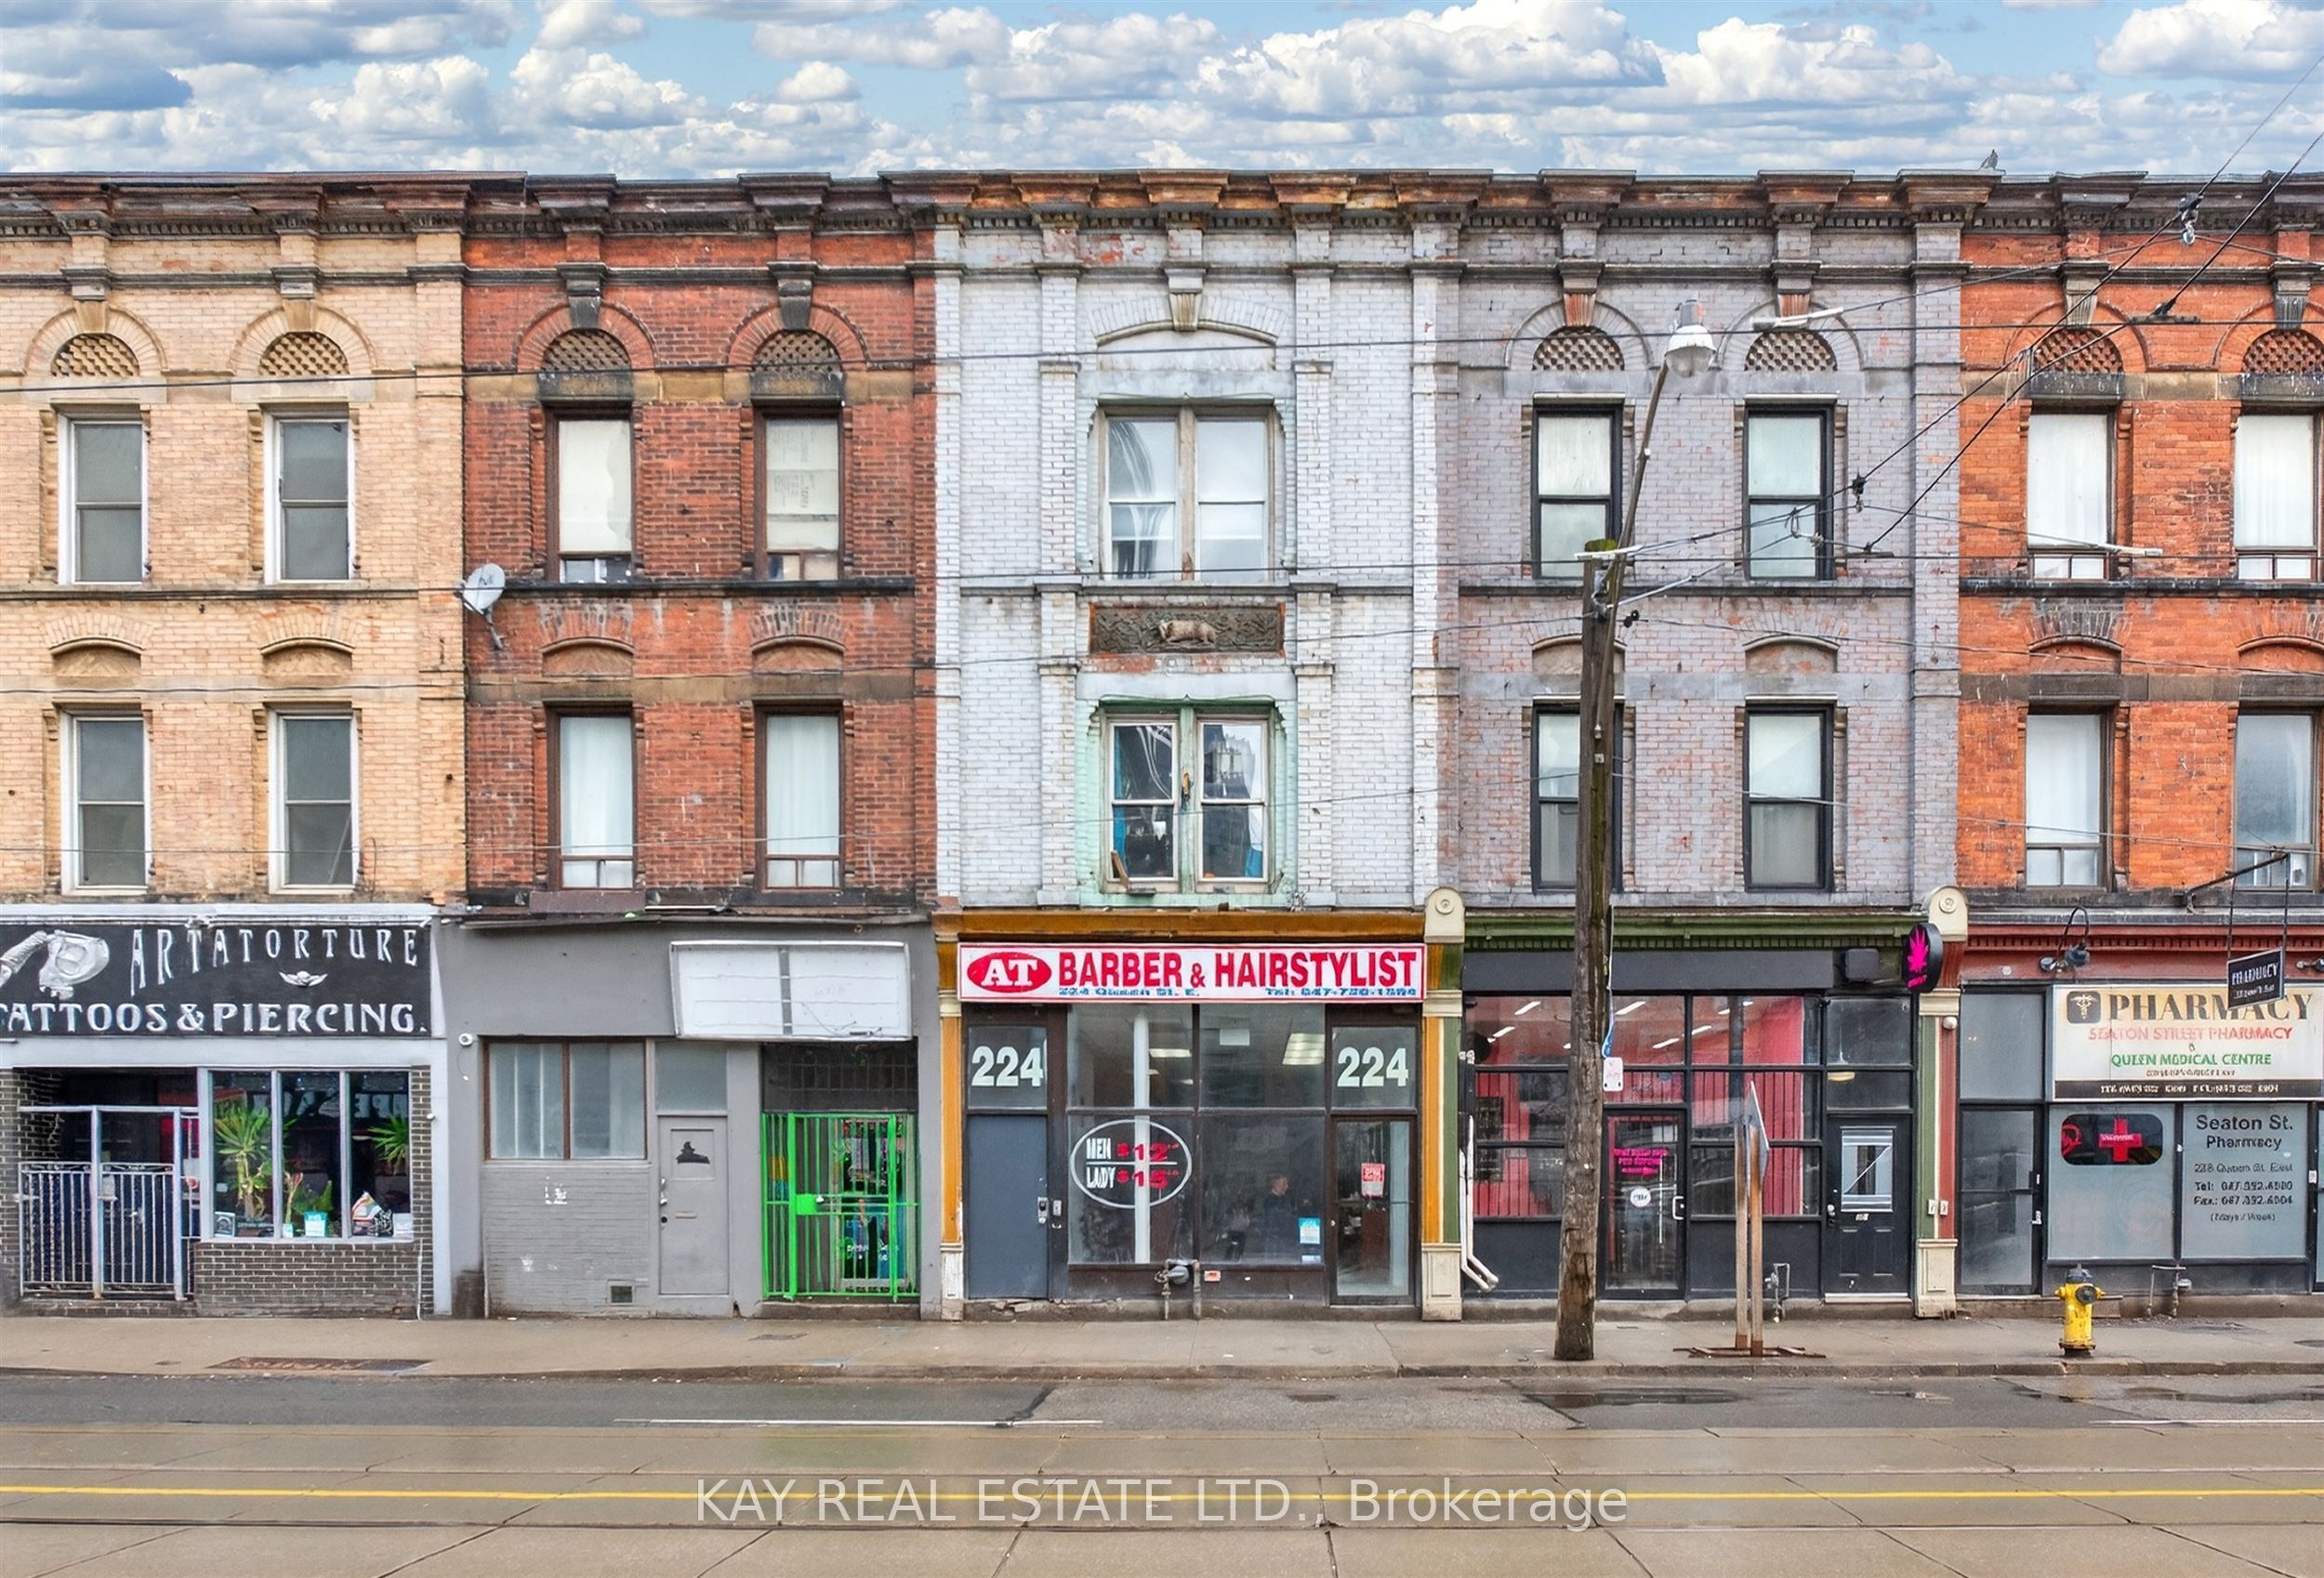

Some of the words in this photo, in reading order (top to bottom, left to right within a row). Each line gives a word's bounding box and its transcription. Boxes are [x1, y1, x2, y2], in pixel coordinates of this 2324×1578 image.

[981, 959, 1037, 986] AT
[1059, 952, 1183, 987] BARBER
[1190, 963, 1206, 988] &
[1215, 952, 1417, 987] HAIRSTYLIST
[177, 1004, 205, 1032] &
[213, 1003, 428, 1032] PIERCING.
[2109, 993, 2312, 1020] PHARMACY
[2208, 1026, 2293, 1041] PHARMACY
[971, 1045, 1044, 1086] 224
[1338, 1046, 1409, 1086] 224
[2111, 1054, 2157, 1068] QUEEN
[2160, 1054, 2218, 1067] MEDICAL
[2222, 1054, 2272, 1066] CENTRE
[2196, 1114, 2263, 1130] Seaton
[2269, 1114, 2294, 1130] St.
[1086, 1137, 1111, 1160] MEN
[2206, 1135, 2282, 1151] Pharmacy
[1086, 1166, 1116, 1189] LADY
[2195, 1181, 2215, 1190] Tel:
